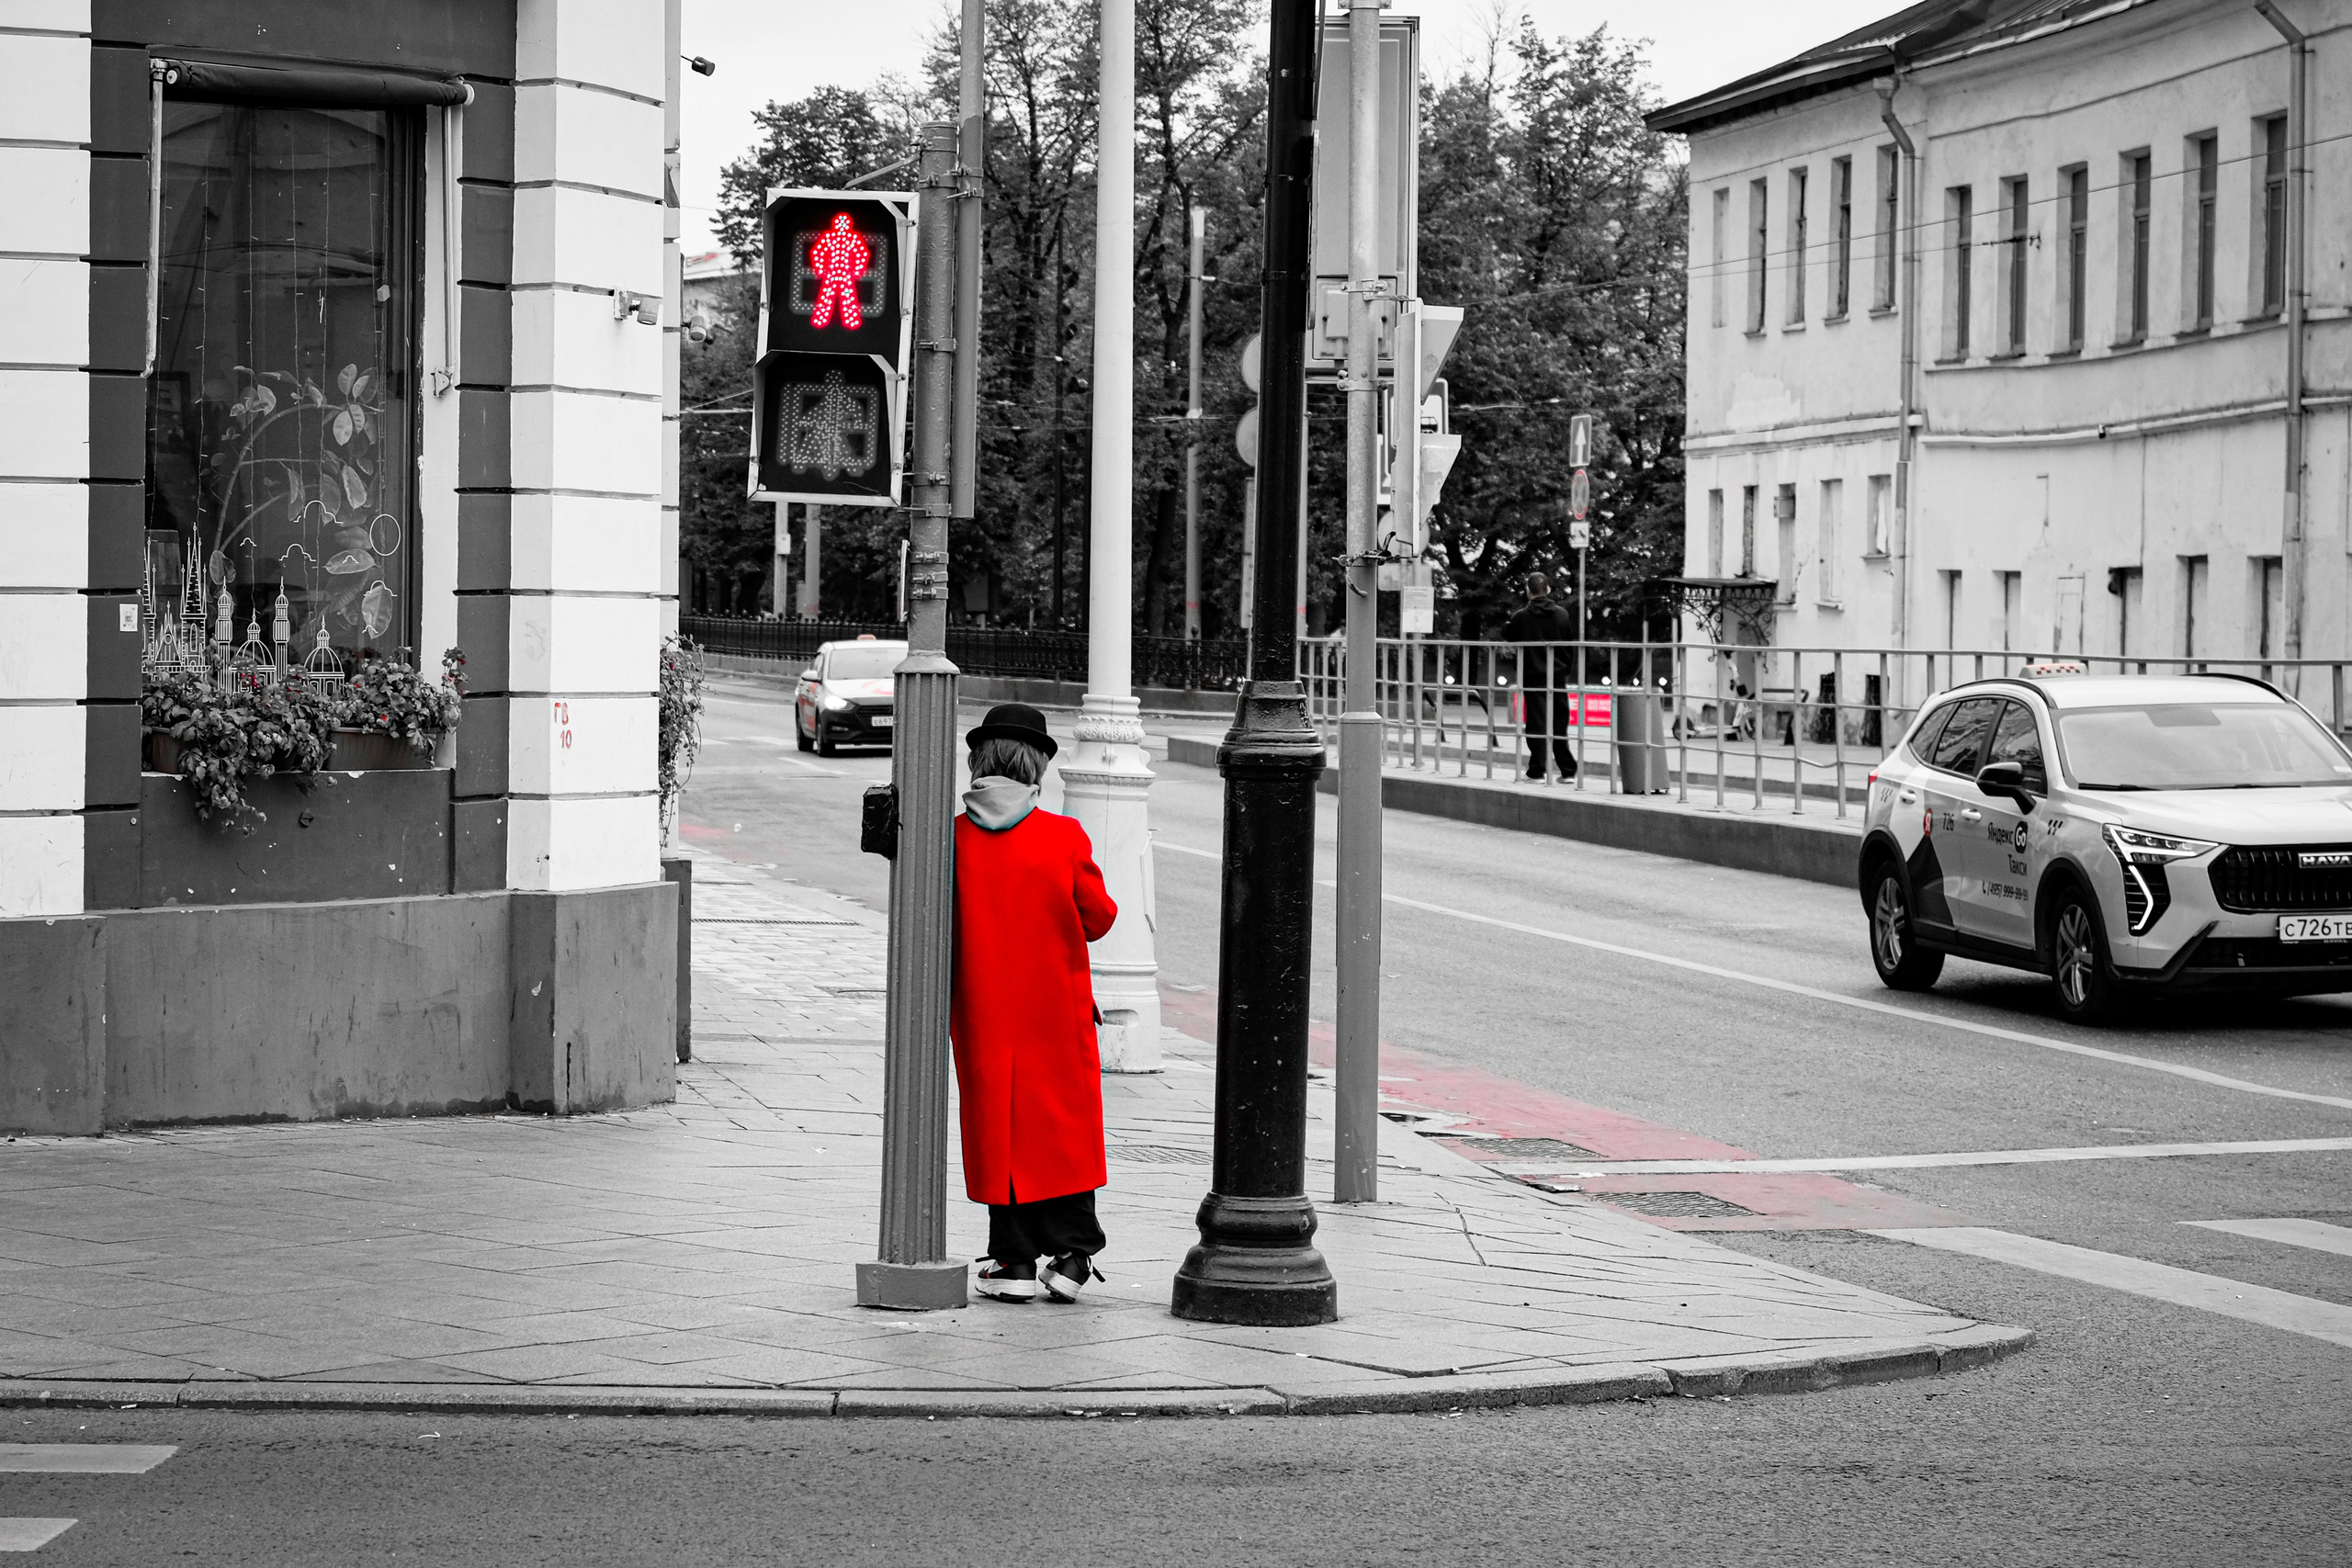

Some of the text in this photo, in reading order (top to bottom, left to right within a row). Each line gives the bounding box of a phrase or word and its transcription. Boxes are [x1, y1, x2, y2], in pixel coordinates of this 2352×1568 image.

[560, 729, 571, 749] 10
[1987, 822, 2027, 847] Яндекс Go
[2007, 853, 2028, 876] Такси
